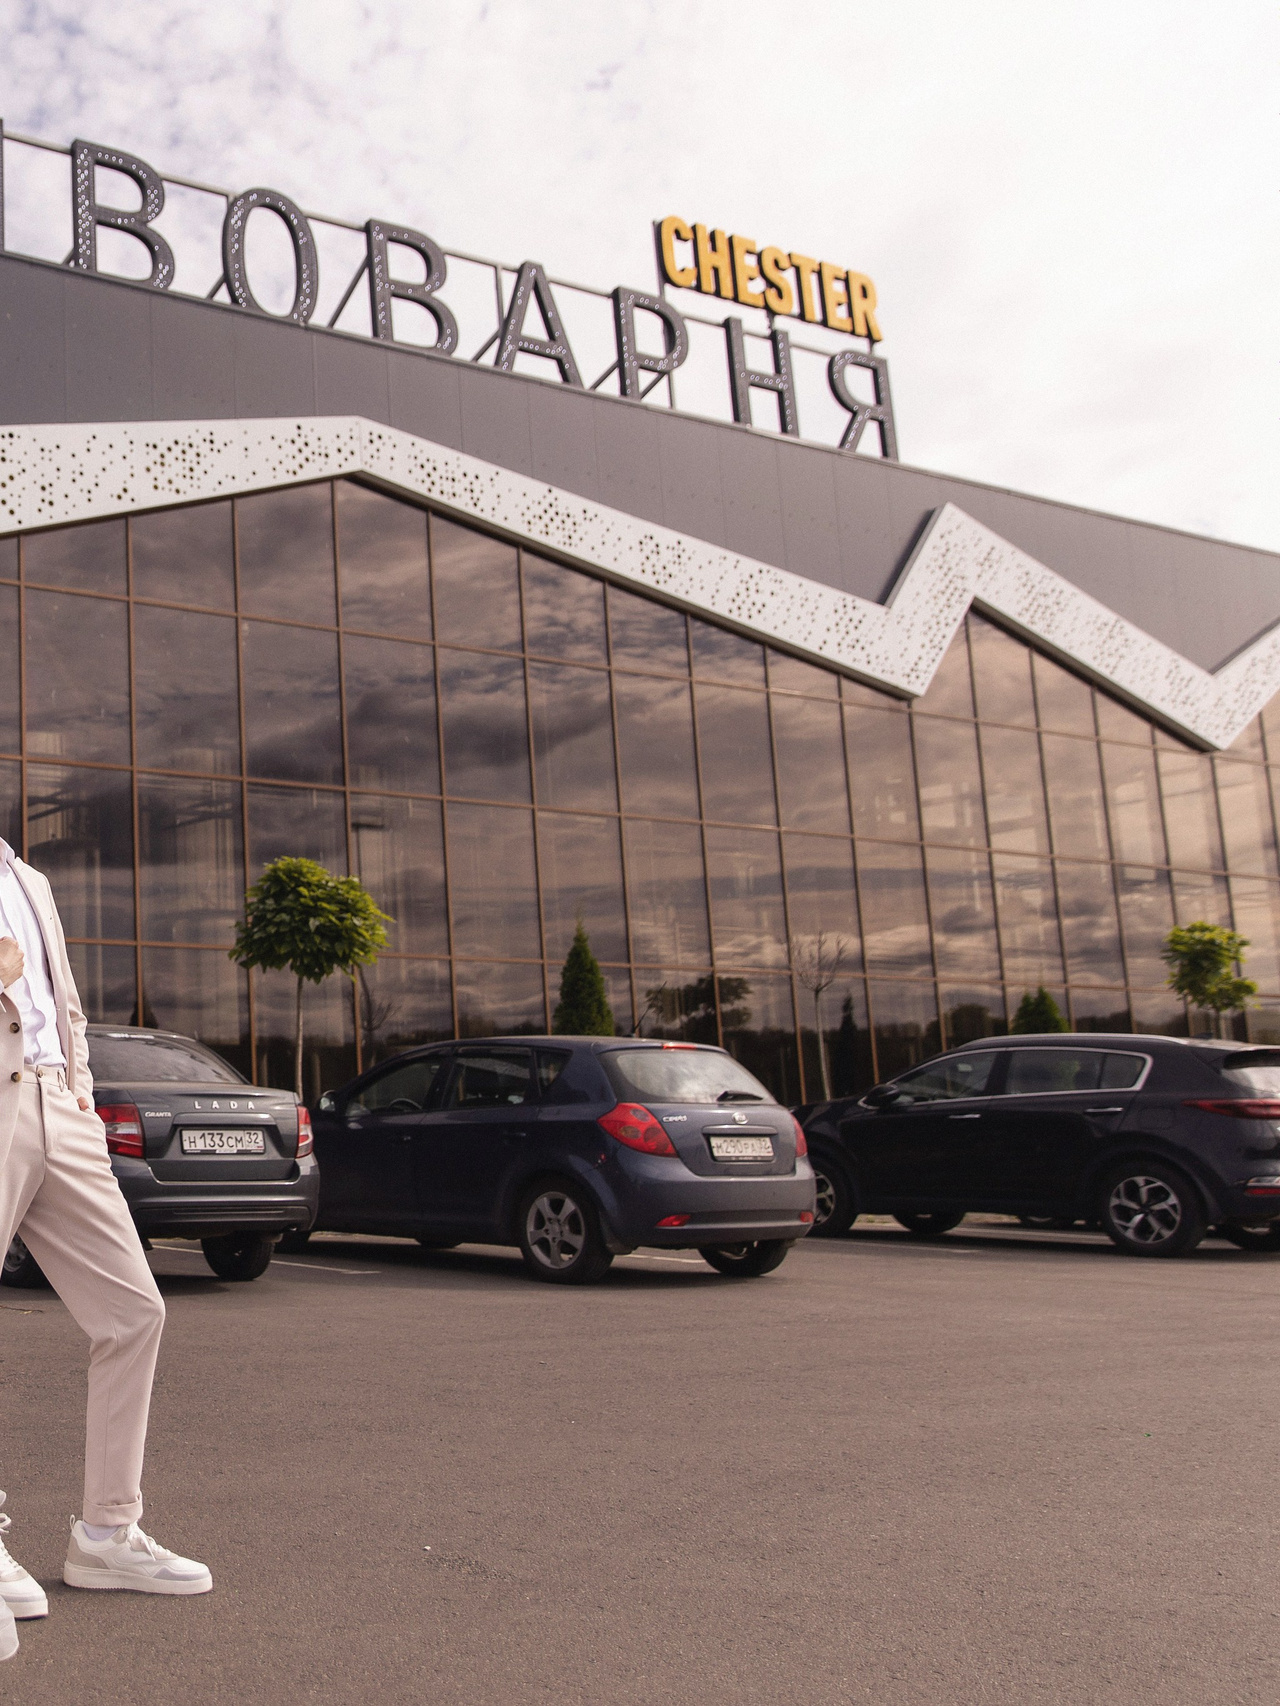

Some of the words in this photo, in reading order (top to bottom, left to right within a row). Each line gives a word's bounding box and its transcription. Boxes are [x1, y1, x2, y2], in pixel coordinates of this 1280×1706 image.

[656, 215, 883, 342] CHESTER
[193, 1100, 256, 1110] LADA
[144, 1110, 172, 1118] GRANTA
[246, 1132, 260, 1145] 32
